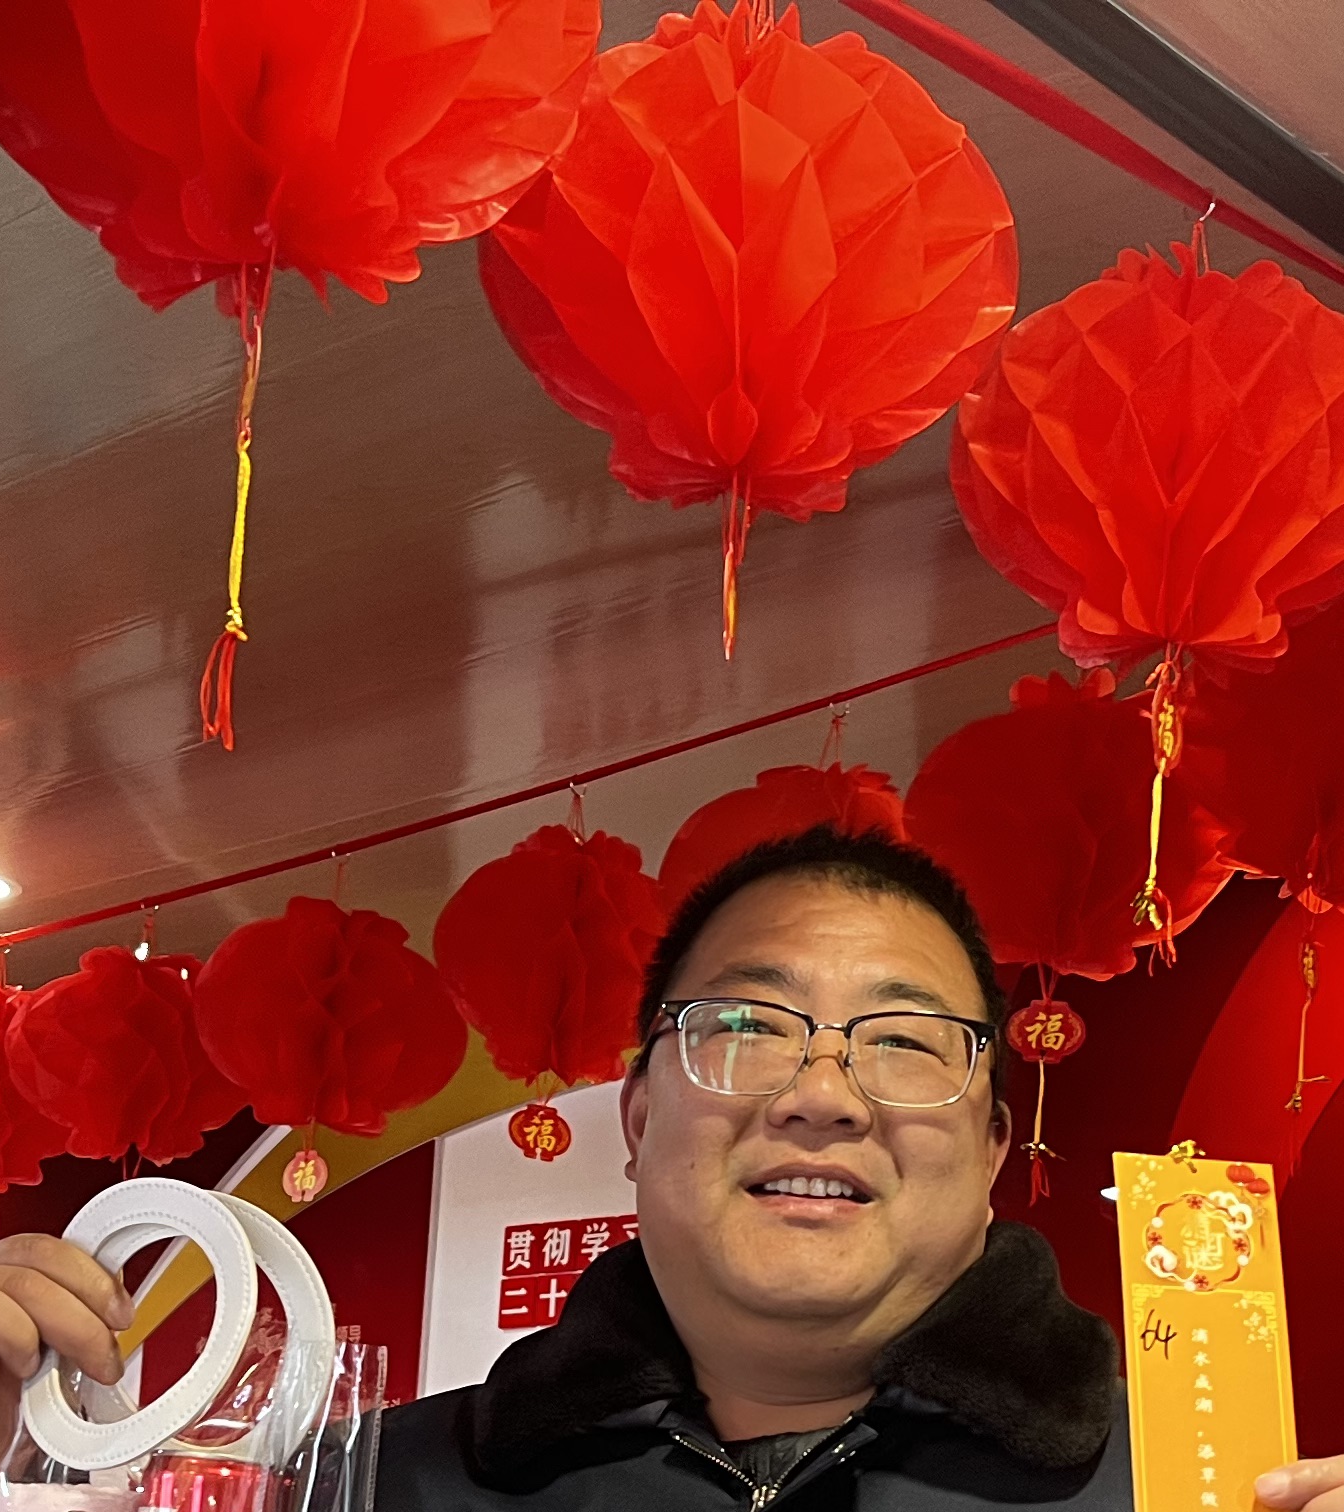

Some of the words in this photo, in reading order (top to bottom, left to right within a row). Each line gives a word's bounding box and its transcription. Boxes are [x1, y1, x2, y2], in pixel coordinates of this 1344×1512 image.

[1025, 1012, 1067, 1050] 福
[524, 1114, 556, 1152] 福
[293, 1160, 317, 1190] 福
[500, 1278, 568, 1319] 二十
[1140, 1308, 1177, 1360] 64
